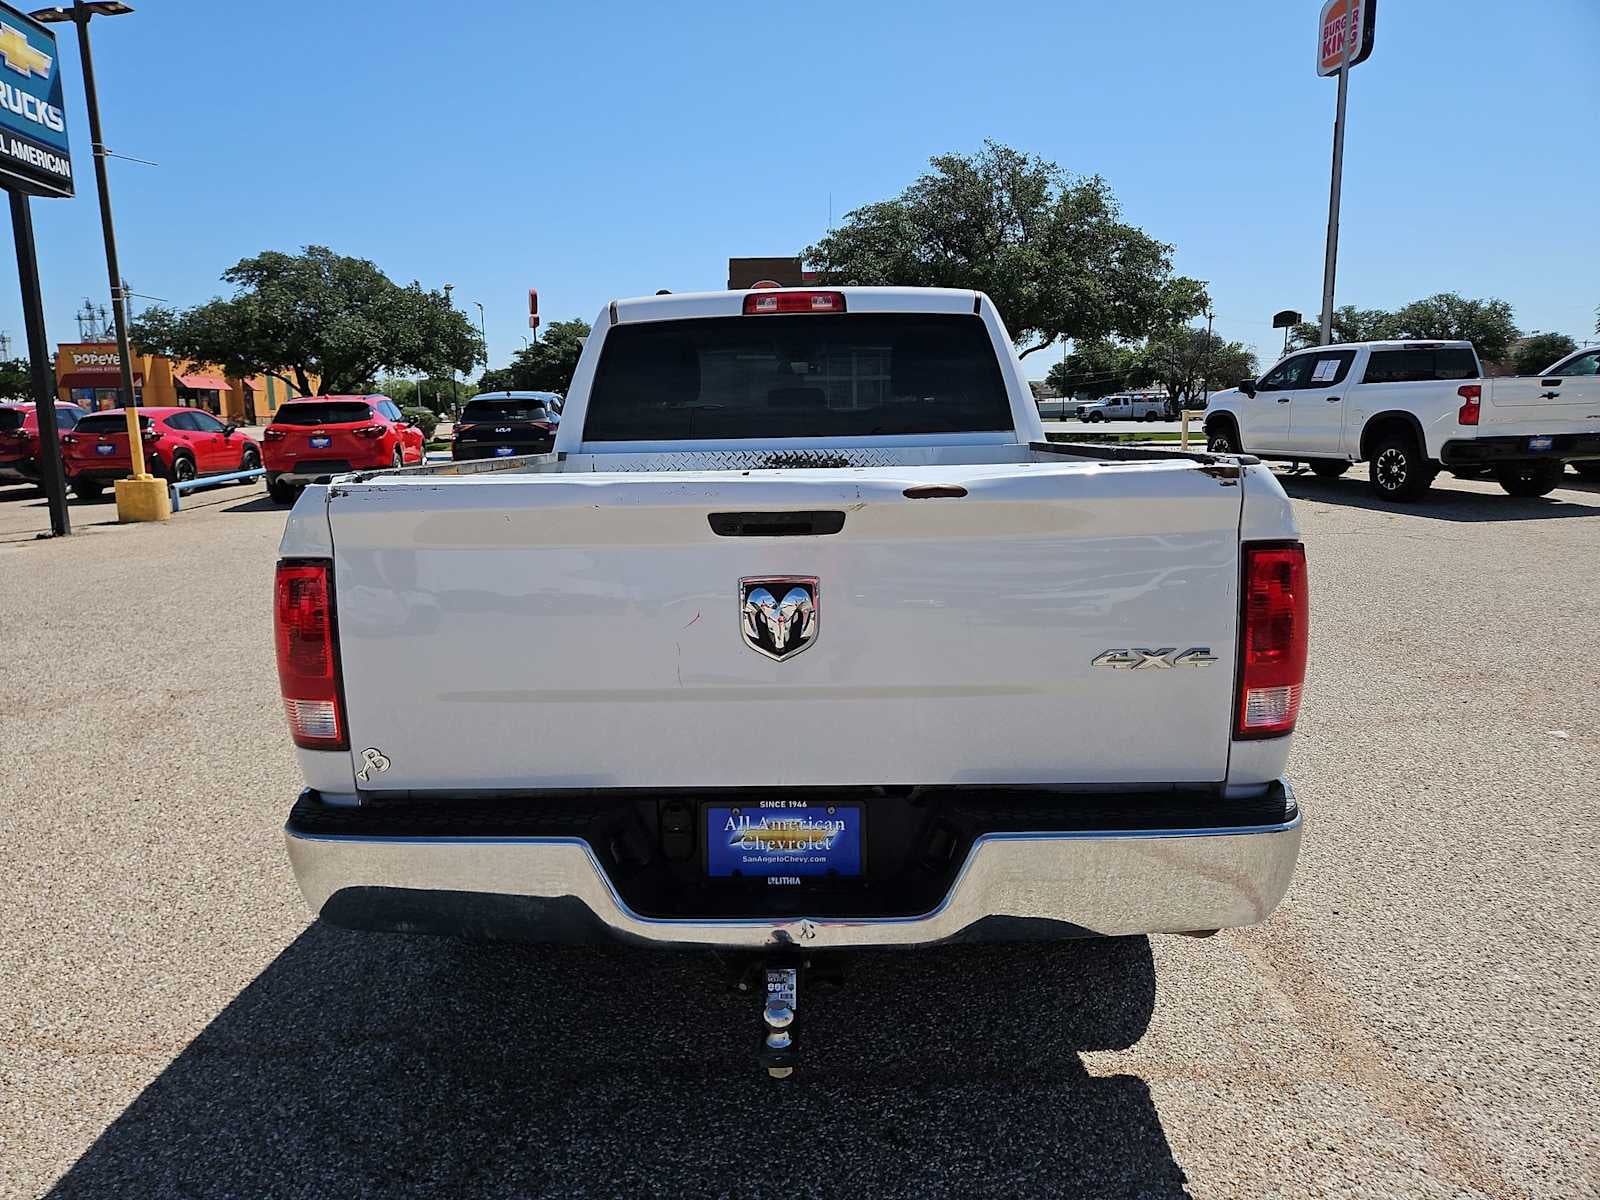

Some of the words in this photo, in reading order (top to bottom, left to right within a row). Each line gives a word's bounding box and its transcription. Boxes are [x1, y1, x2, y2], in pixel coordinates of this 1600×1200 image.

[1323, 9, 1359, 40] BURGR
[11, 139, 71, 177] AMERICAN
[1091, 648, 1219, 669] 4X4
[724, 815, 751, 831] All
[759, 816, 846, 831] American
[740, 835, 834, 850] Chevrolet
